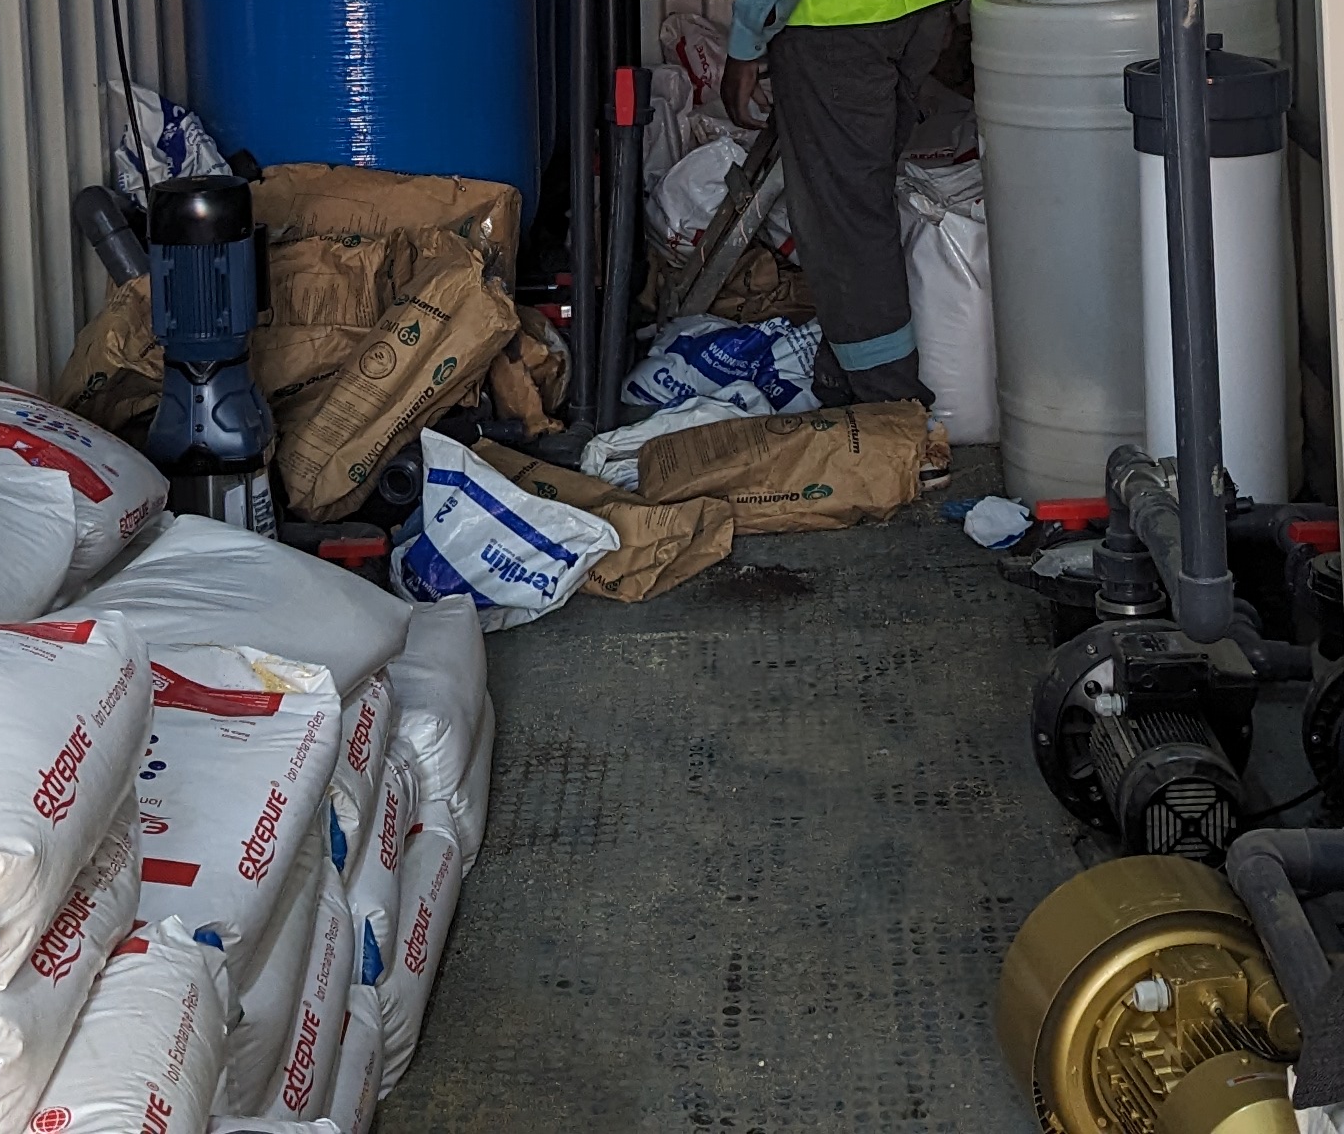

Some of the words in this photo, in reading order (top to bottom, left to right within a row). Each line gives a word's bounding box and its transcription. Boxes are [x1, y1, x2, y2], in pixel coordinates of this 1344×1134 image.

[399, 327, 419, 346] 65
[384, 386, 435, 443] Quantum
[736, 492, 800, 504] Quantum
[91, 711, 106, 728] Ion
[99, 678, 128, 717] Exchange
[289, 729, 316, 769] Exchange
[284, 767, 299, 783] Ion
[325, 916, 339, 945] Resin
[316, 944, 336, 987] Exchange
[182, 982, 200, 1015] Resin
[314, 984, 327, 1003] Ion
[168, 1011, 194, 1065] Exchange
[162, 1062, 181, 1086] Ion
